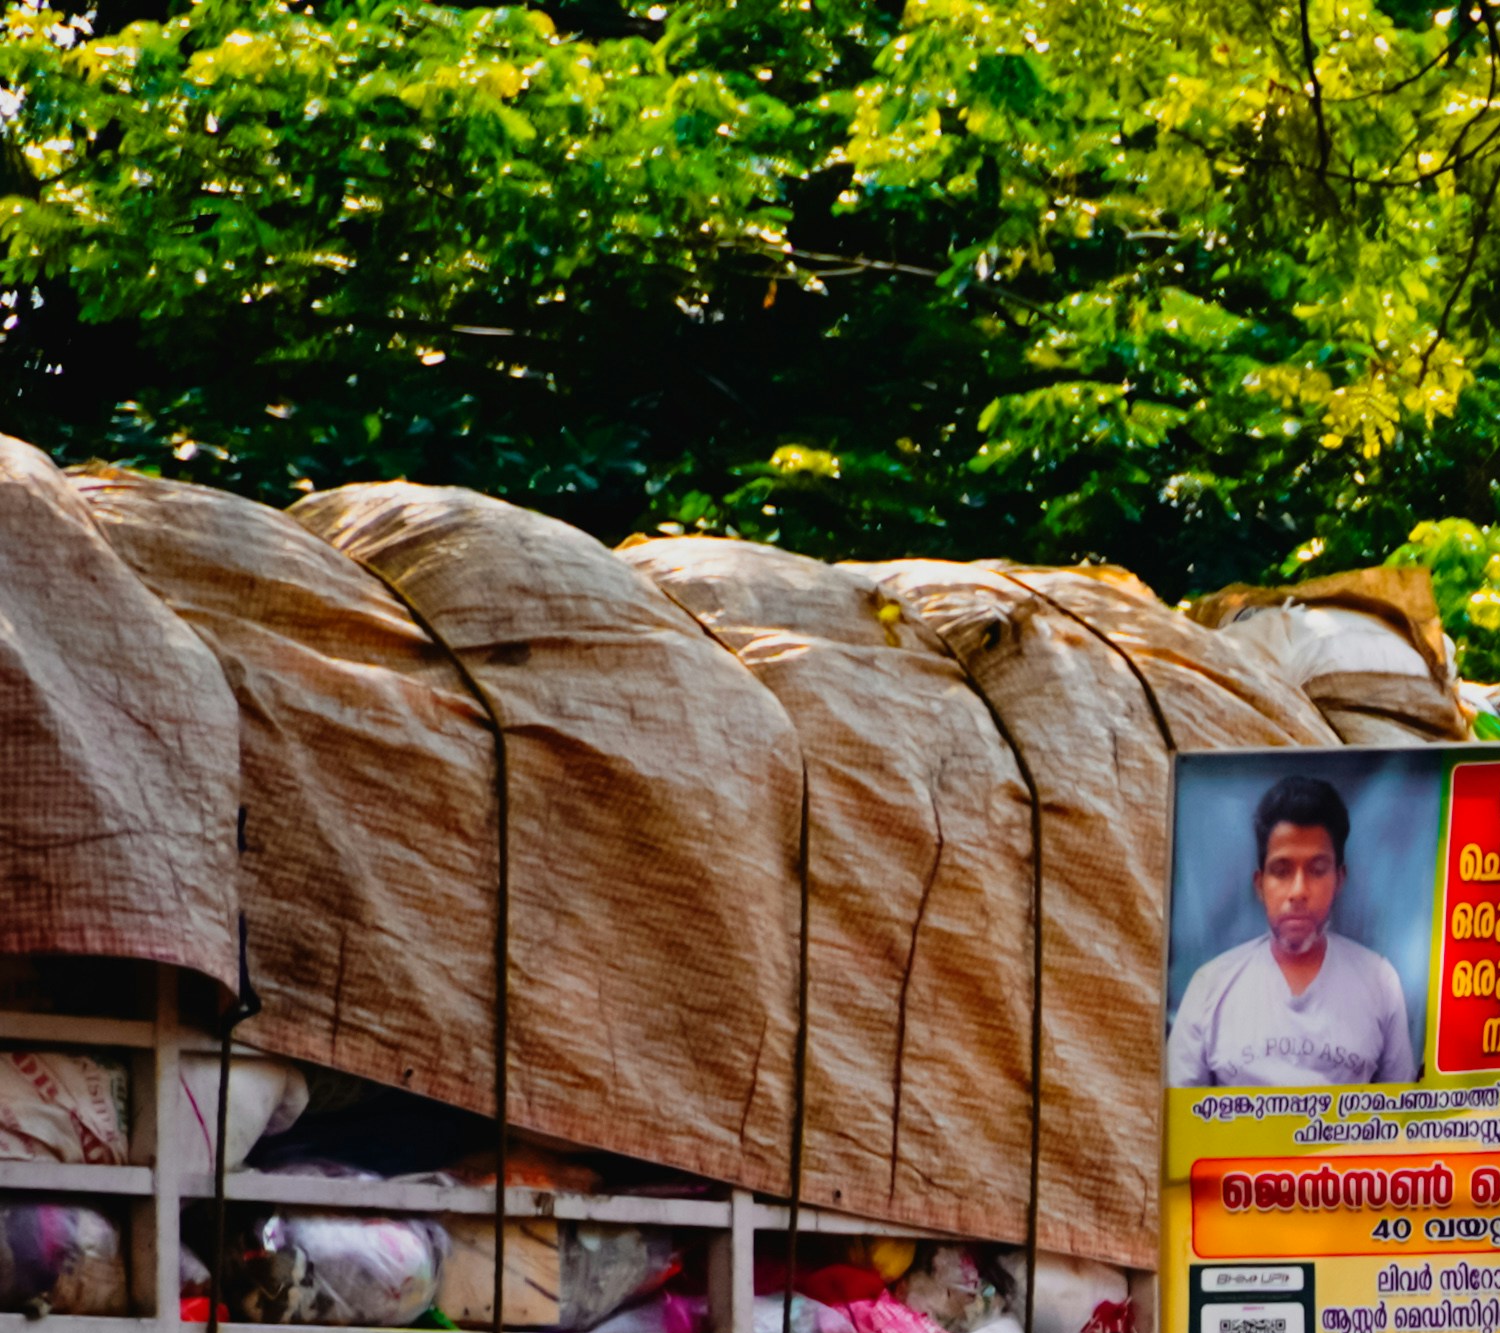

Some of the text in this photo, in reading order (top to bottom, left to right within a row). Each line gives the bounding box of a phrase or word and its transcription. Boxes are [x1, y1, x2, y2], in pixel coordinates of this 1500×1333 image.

[1265, 1037, 1314, 1057] POLO
[1371, 1218, 1412, 1240] 40
[1378, 1262, 1432, 1292] ലിവർ
